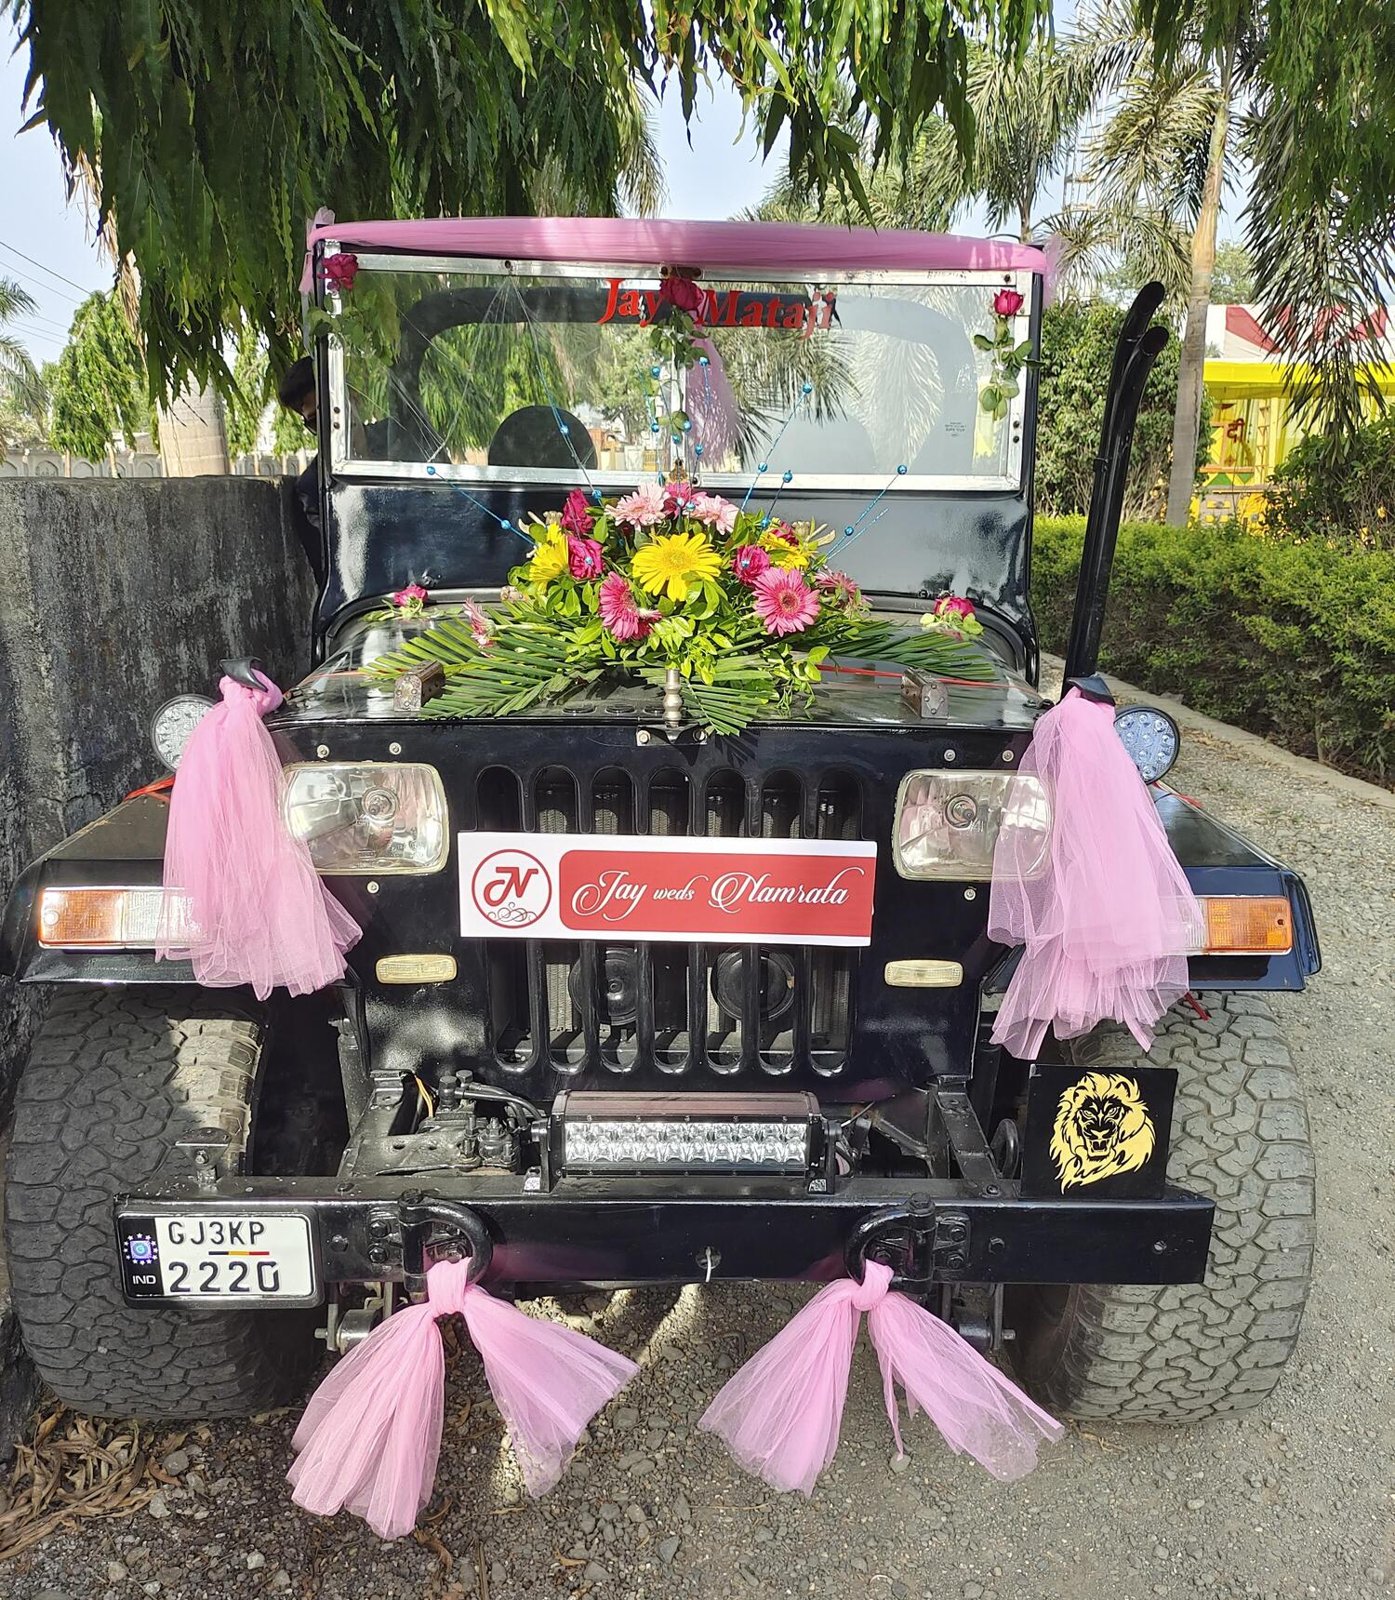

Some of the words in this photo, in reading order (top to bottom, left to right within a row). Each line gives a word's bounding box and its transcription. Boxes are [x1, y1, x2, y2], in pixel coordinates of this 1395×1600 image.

[594, 277, 666, 328] Jay
[696, 289, 835, 340] Mataji
[571, 870, 648, 922] Jay
[652, 875, 709, 901] weds
[708, 866, 865, 914] Namrata
[168, 1221, 265, 1245] GJ3KP
[132, 1275, 157, 1285] IND
[168, 1261, 280, 1292] 2220
